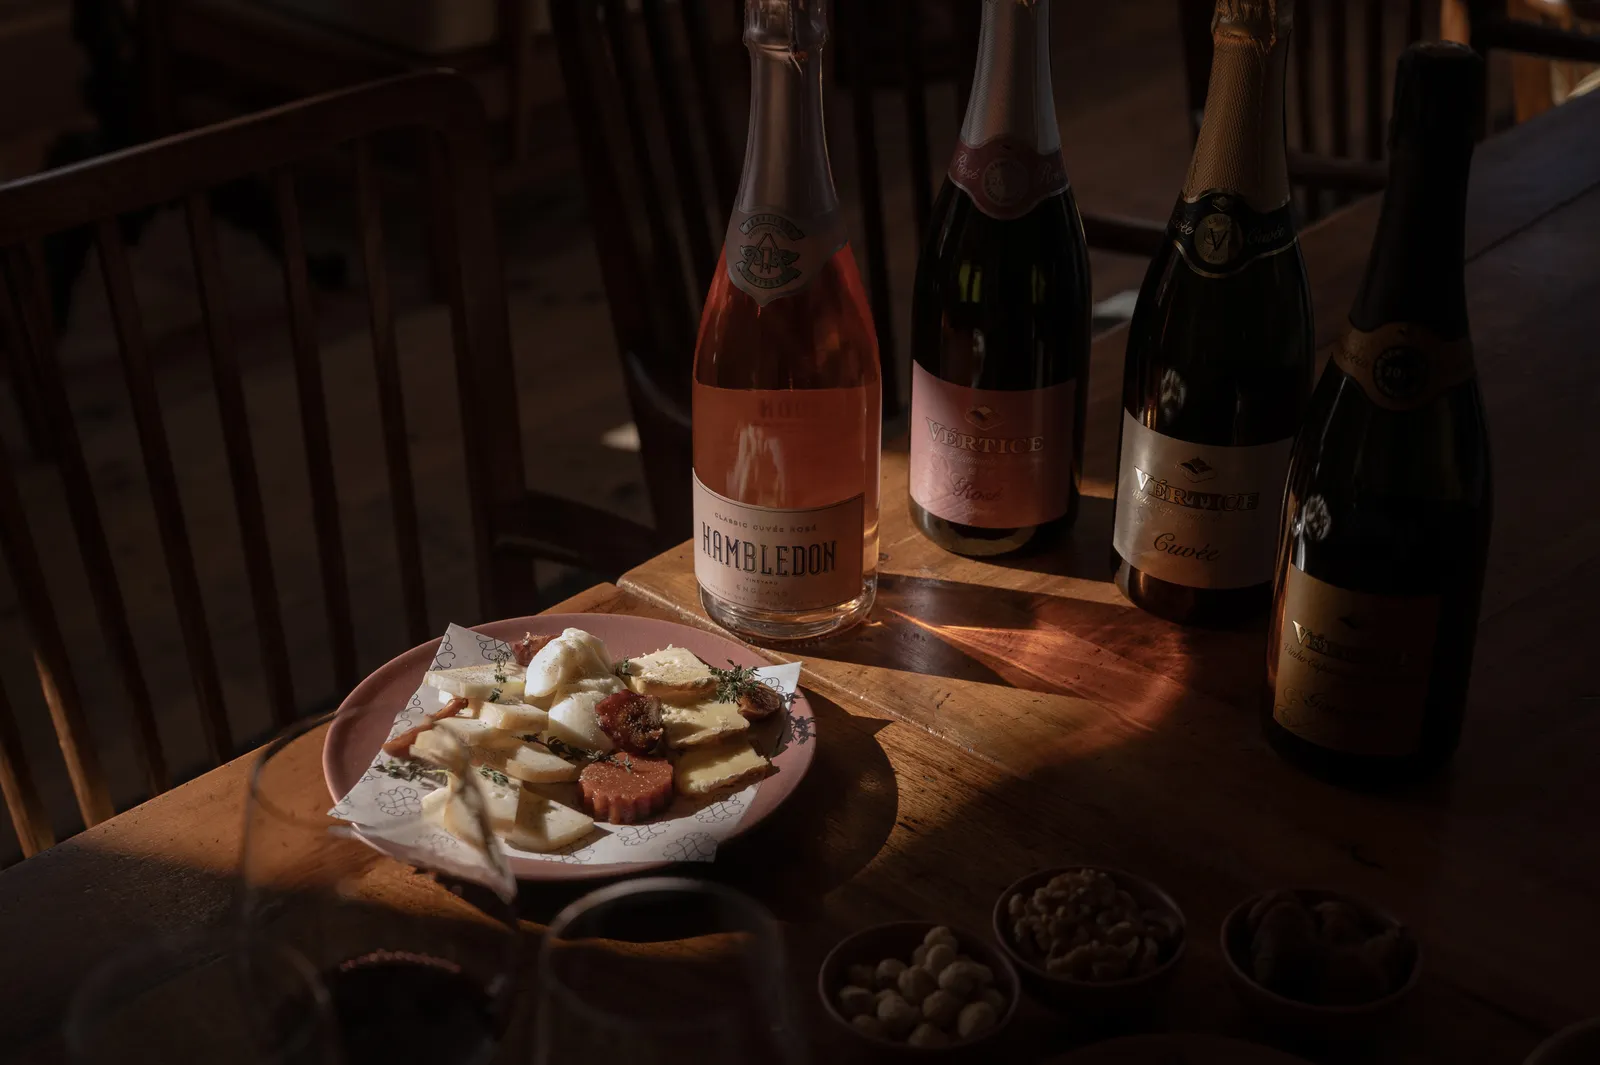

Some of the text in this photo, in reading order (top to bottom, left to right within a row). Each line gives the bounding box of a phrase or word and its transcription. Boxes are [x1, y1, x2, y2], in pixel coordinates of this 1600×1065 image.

[926, 416, 1044, 455] VÉRTICE
[951, 476, 1004, 501] Rosé
[1134, 466, 1260, 511] VÉRTICE
[714, 511, 818, 534] CLASSIC CUVÉE ROSÉ
[702, 521, 838, 577] HAMBLEDON
[1153, 532, 1222, 561] Cuvée
[736, 584, 789, 598] ENGLAND
[745, 576, 779, 586] VINEYARD
